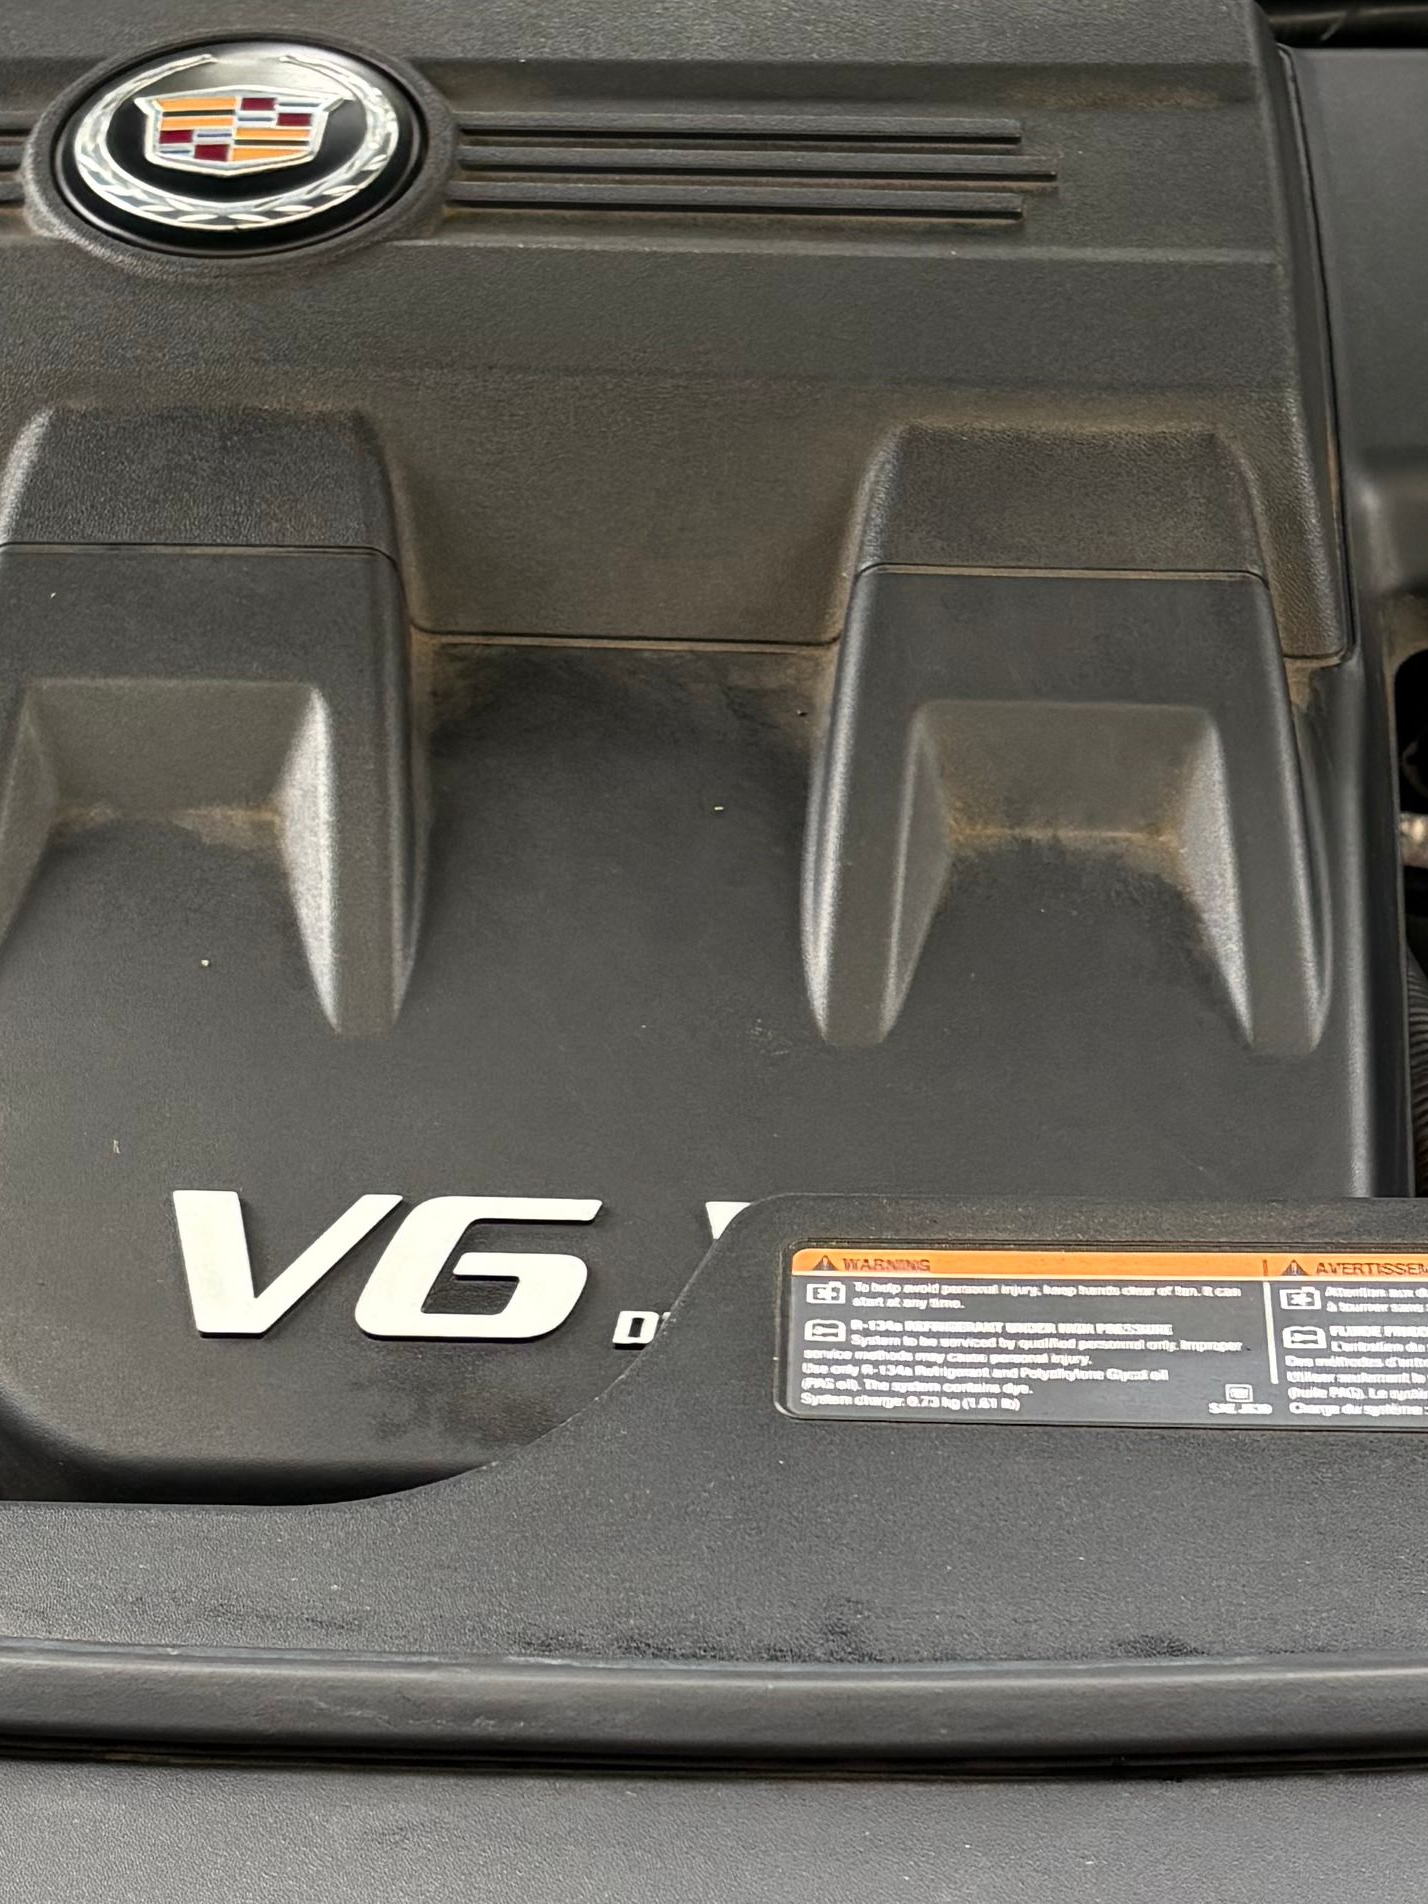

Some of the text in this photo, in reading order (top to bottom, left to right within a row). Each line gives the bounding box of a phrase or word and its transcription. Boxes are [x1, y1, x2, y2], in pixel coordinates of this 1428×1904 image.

[173, 1189, 604, 1339] V6
[843, 1258, 931, 1272] WARNING
[853, 1281, 869, 1293] To
[871, 1282, 901, 1295] help
[903, 1283, 939, 1294] avoid
[1078, 1285, 1120, 1296] hands
[1157, 1286, 1174, 1296] of
[1215, 1287, 1241, 1297] can
[852, 1297, 884, 1307] start
[886, 1298, 900, 1307] at
[903, 1299, 927, 1310] any
[851, 1320, 902, 1331] R-134a
[851, 1334, 900, 1348] System
[903, 1336, 917, 1346] to
[919, 1336, 937, 1347] be
[940, 1336, 997, 1348] serviced
[999, 1337, 1016, 1350] by
[804, 1349, 852, 1360] service
[855, 1350, 912, 1361] methods
[915, 1352, 945, 1363] may
[802, 1363, 828, 1375] Use
[830, 1364, 859, 1376] only
[862, 1365, 912, 1376] R-134a
[915, 1366, 989, 1379] Refrigerant
[992, 1367, 1018, 1378] and
[864, 1379, 889, 1391] The
[891, 1382, 940, 1393] system
[943, 1382, 1000, 1394] contains
[801, 1393, 852, 1406] System
[941, 1396, 960, 1410] kg
